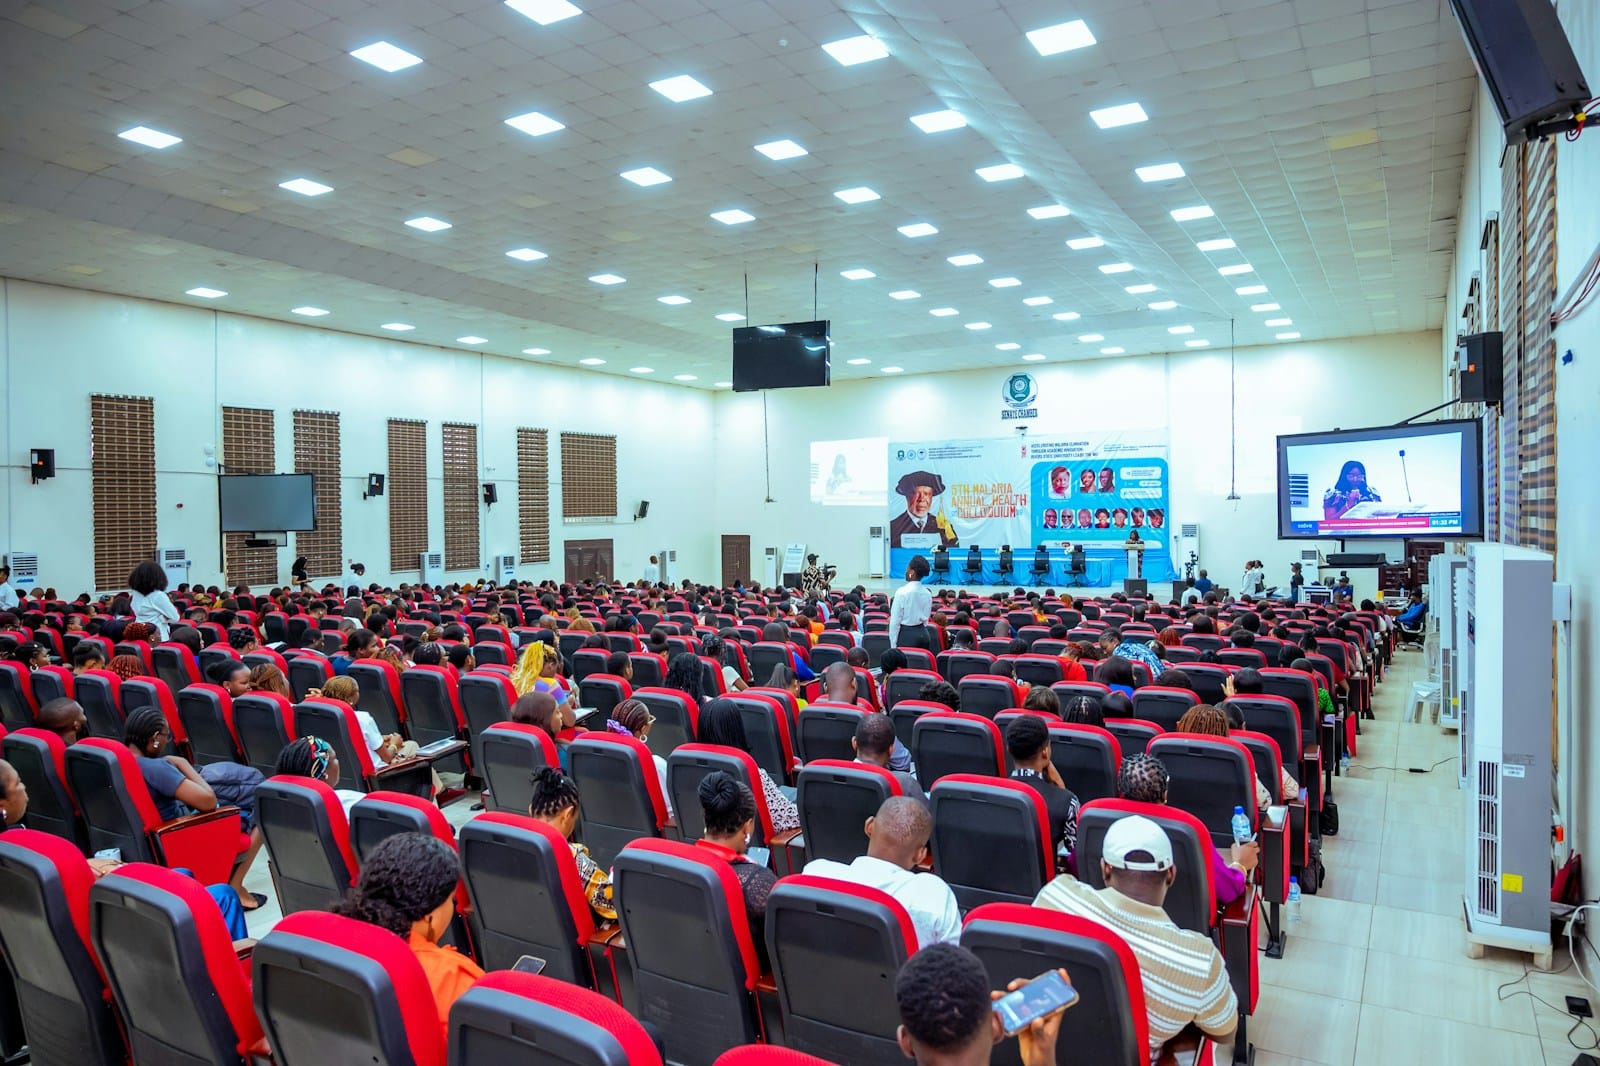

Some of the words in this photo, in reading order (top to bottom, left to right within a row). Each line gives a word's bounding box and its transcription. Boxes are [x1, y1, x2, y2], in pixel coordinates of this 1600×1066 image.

[973, 483, 1012, 495] MALARIA
[952, 495, 986, 507] ANNUAL
[992, 493, 1027, 506] HEALTH
[957, 505, 1016, 518] COLLOQUIUM
